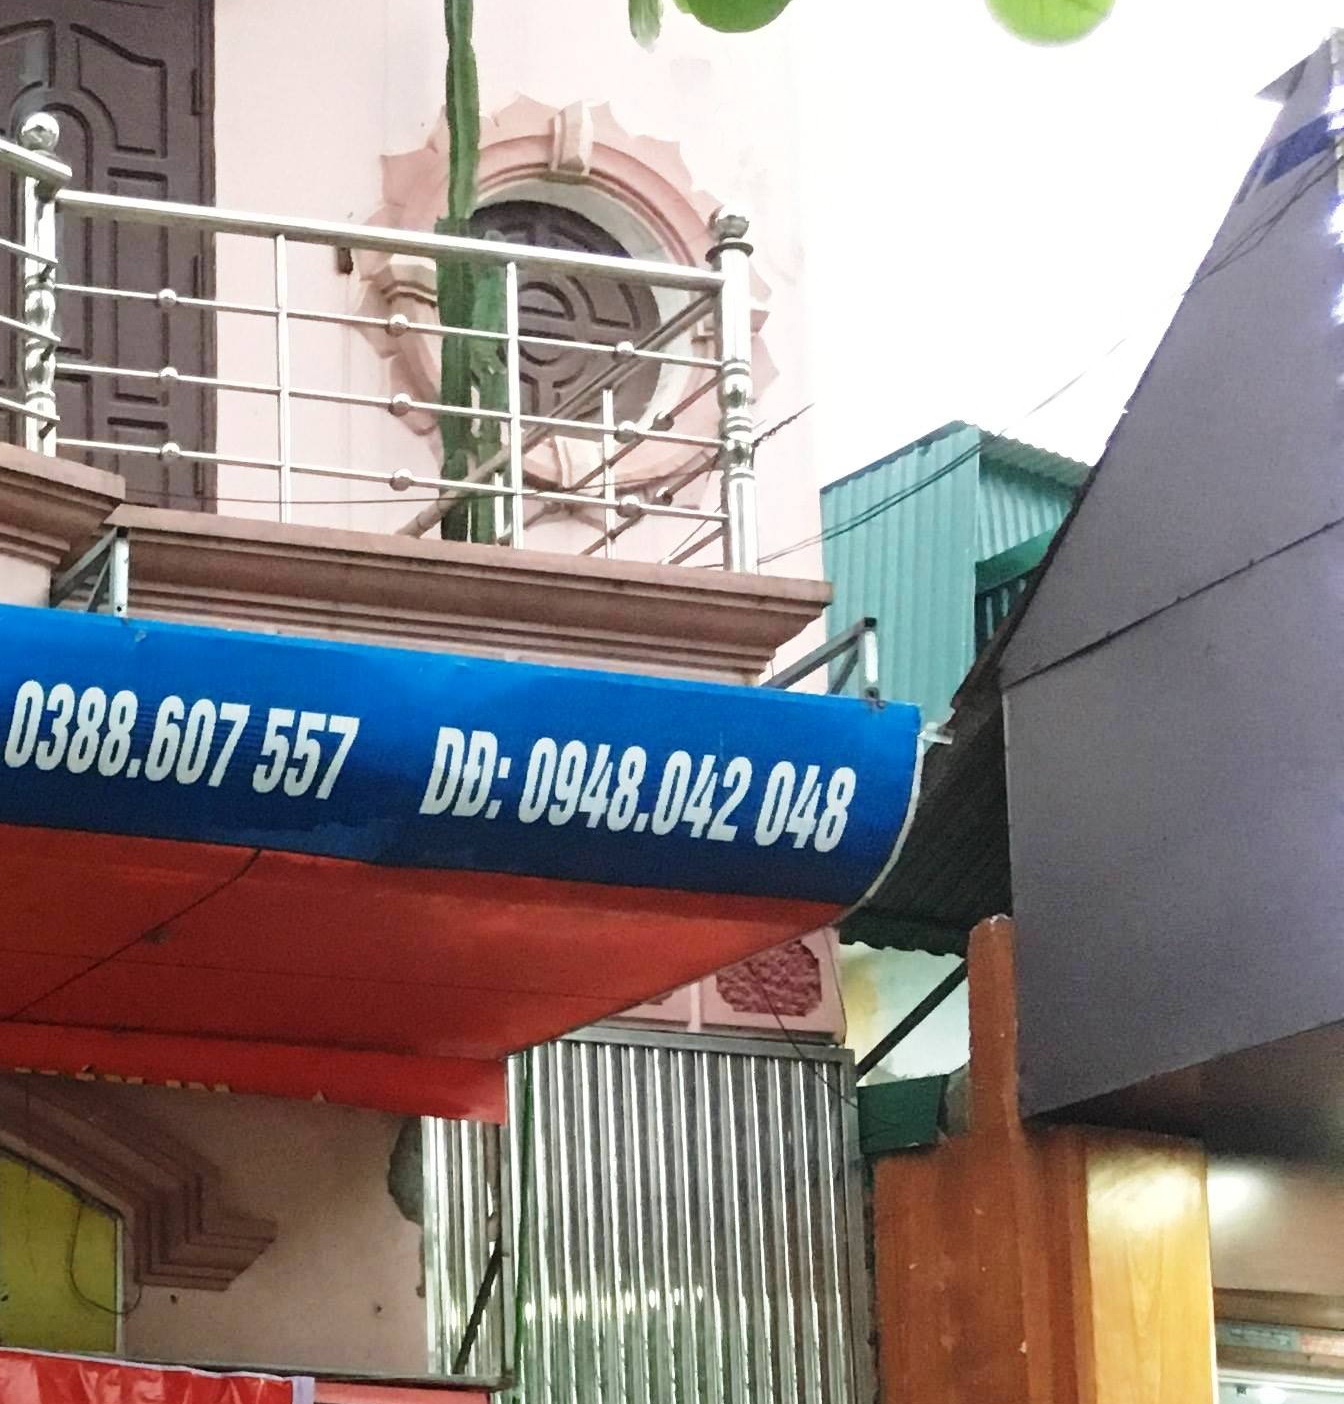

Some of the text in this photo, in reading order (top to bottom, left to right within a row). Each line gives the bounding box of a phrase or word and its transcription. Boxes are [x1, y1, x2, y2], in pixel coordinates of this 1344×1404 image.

[4, 680, 251, 788] 0388.607
[252, 708, 360, 800] 557
[419, 727, 512, 820] DĐ:
[518, 737, 753, 843] 0948.042
[754, 761, 857, 853] 048
